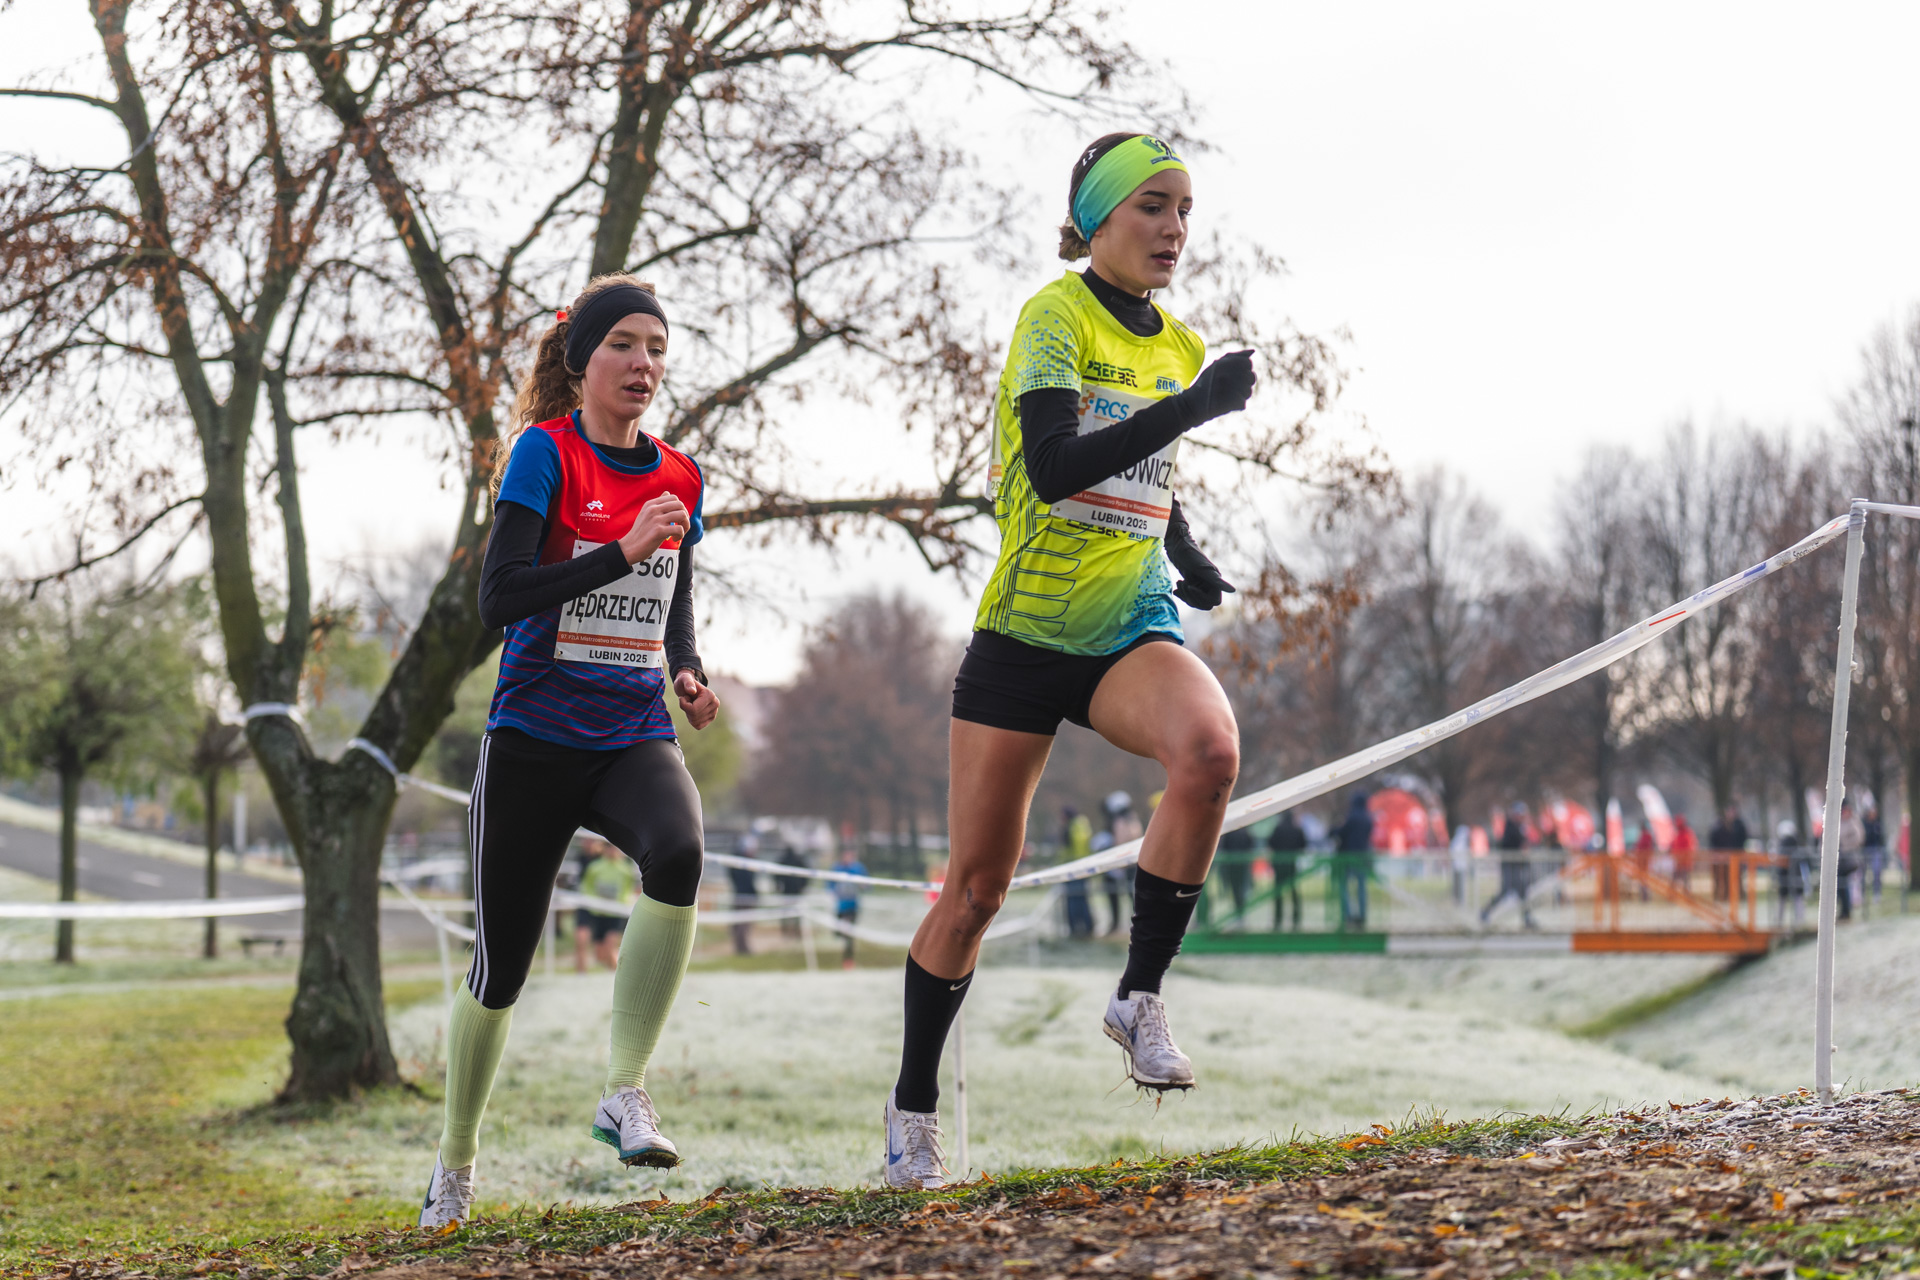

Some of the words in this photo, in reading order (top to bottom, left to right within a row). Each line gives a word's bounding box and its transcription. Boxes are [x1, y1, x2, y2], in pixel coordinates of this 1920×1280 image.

[1094, 397, 1129, 421] RCS
[1115, 457, 1173, 490] OWICZ
[1091, 510, 1125, 526] LUBIN
[1126, 516, 1148, 530] 2025
[580, 635, 610, 645] Mistrzostwa
[610, 638, 625, 646] Polski
[589, 649, 621, 661] LUBIN
[623, 652, 648, 664] 2025
